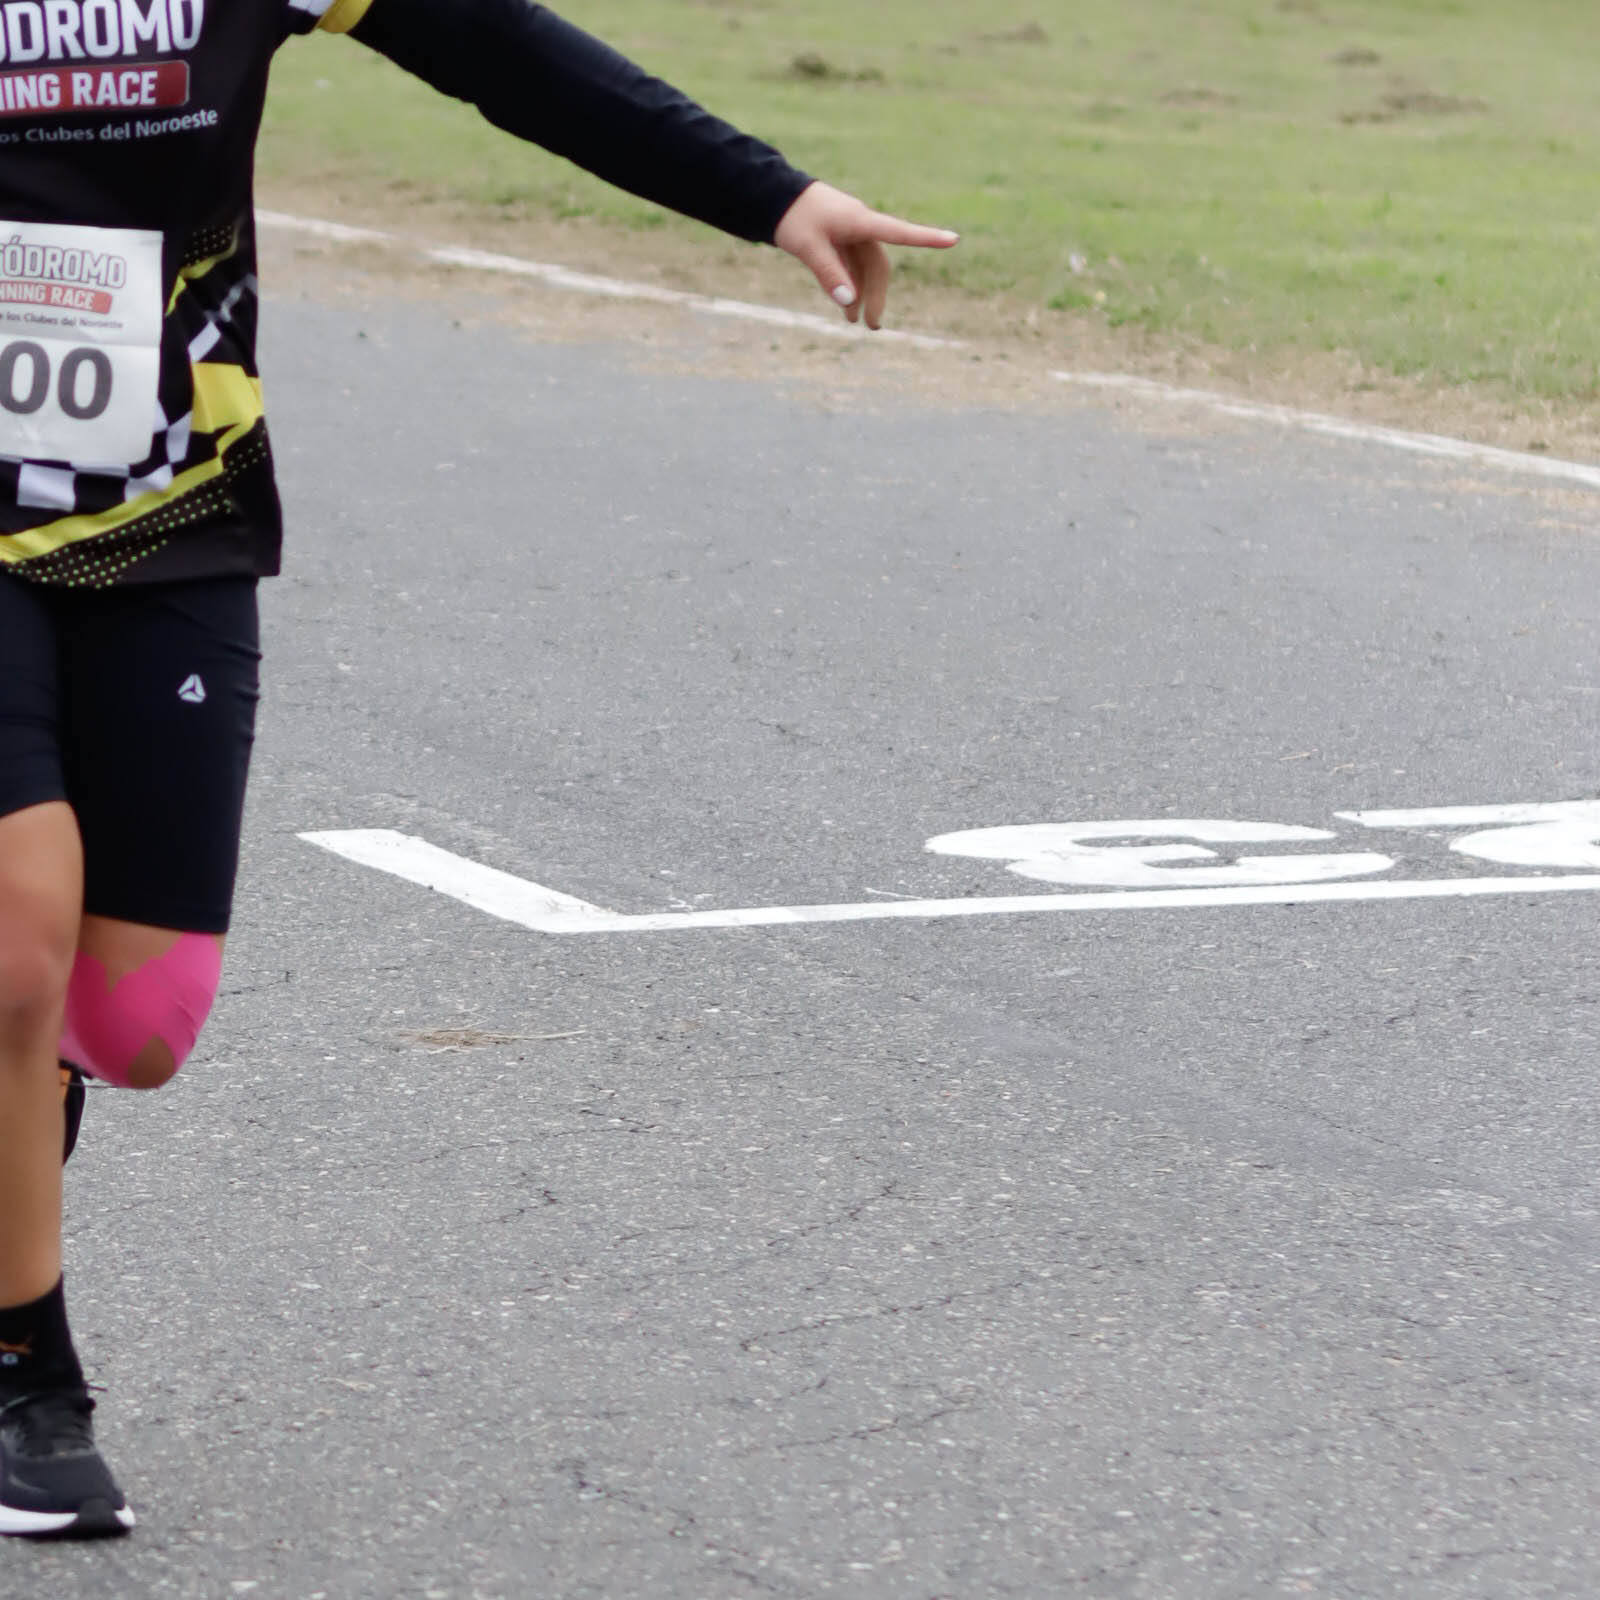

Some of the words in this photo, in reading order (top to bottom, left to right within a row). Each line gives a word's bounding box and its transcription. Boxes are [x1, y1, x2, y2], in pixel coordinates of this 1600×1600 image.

[72, 70, 159, 106] RACE
[25, 126, 95, 142] Clubes
[99, 122, 131, 141] del
[135, 109, 219, 139] Noroeste
[50, 287, 96, 311] RACE
